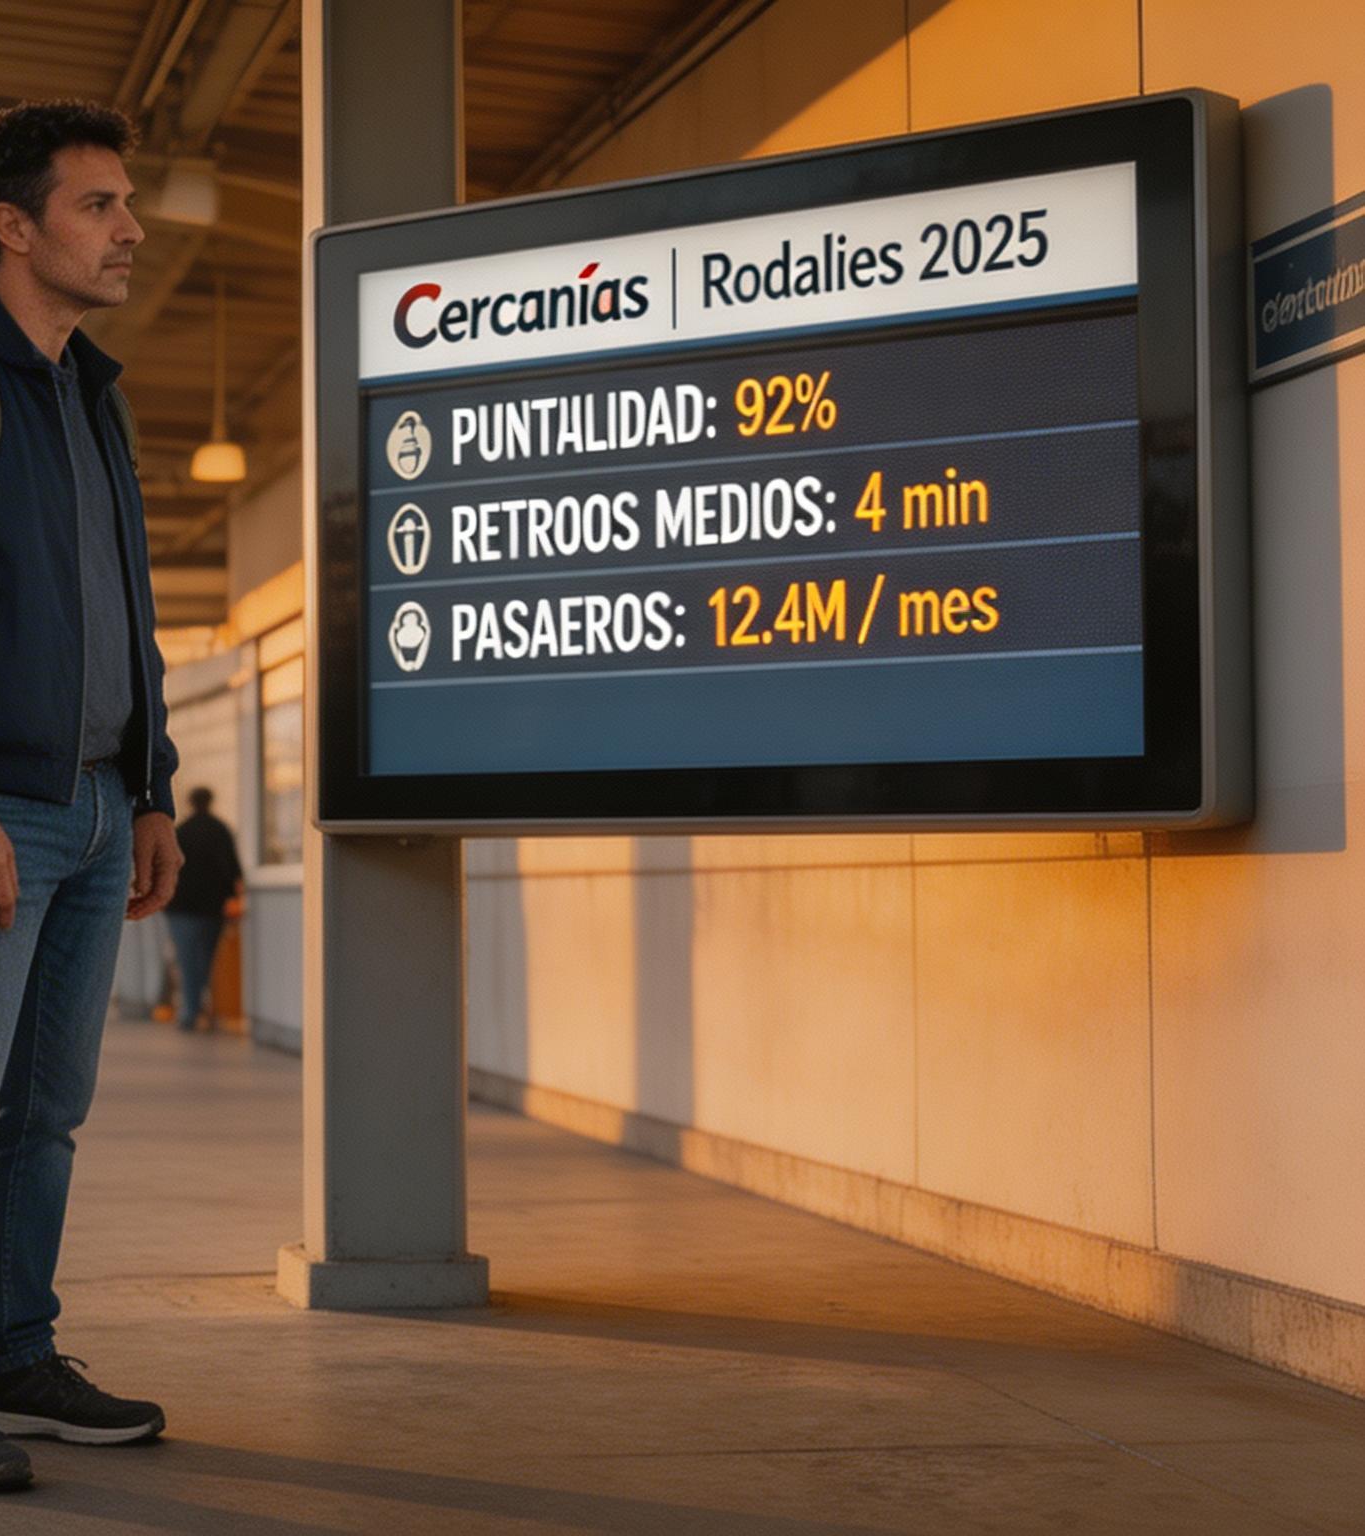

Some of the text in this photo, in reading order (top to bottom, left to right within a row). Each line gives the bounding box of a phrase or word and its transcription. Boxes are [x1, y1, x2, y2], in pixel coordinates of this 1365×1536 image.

[392, 209, 1048, 350] Cercanías Rodalies 2025
[734, 371, 837, 437] 92%
[451, 467, 989, 564] RETROOS MEDIOS: 4 min
[451, 573, 1000, 662] PASAEROS: 12.4M / mes
